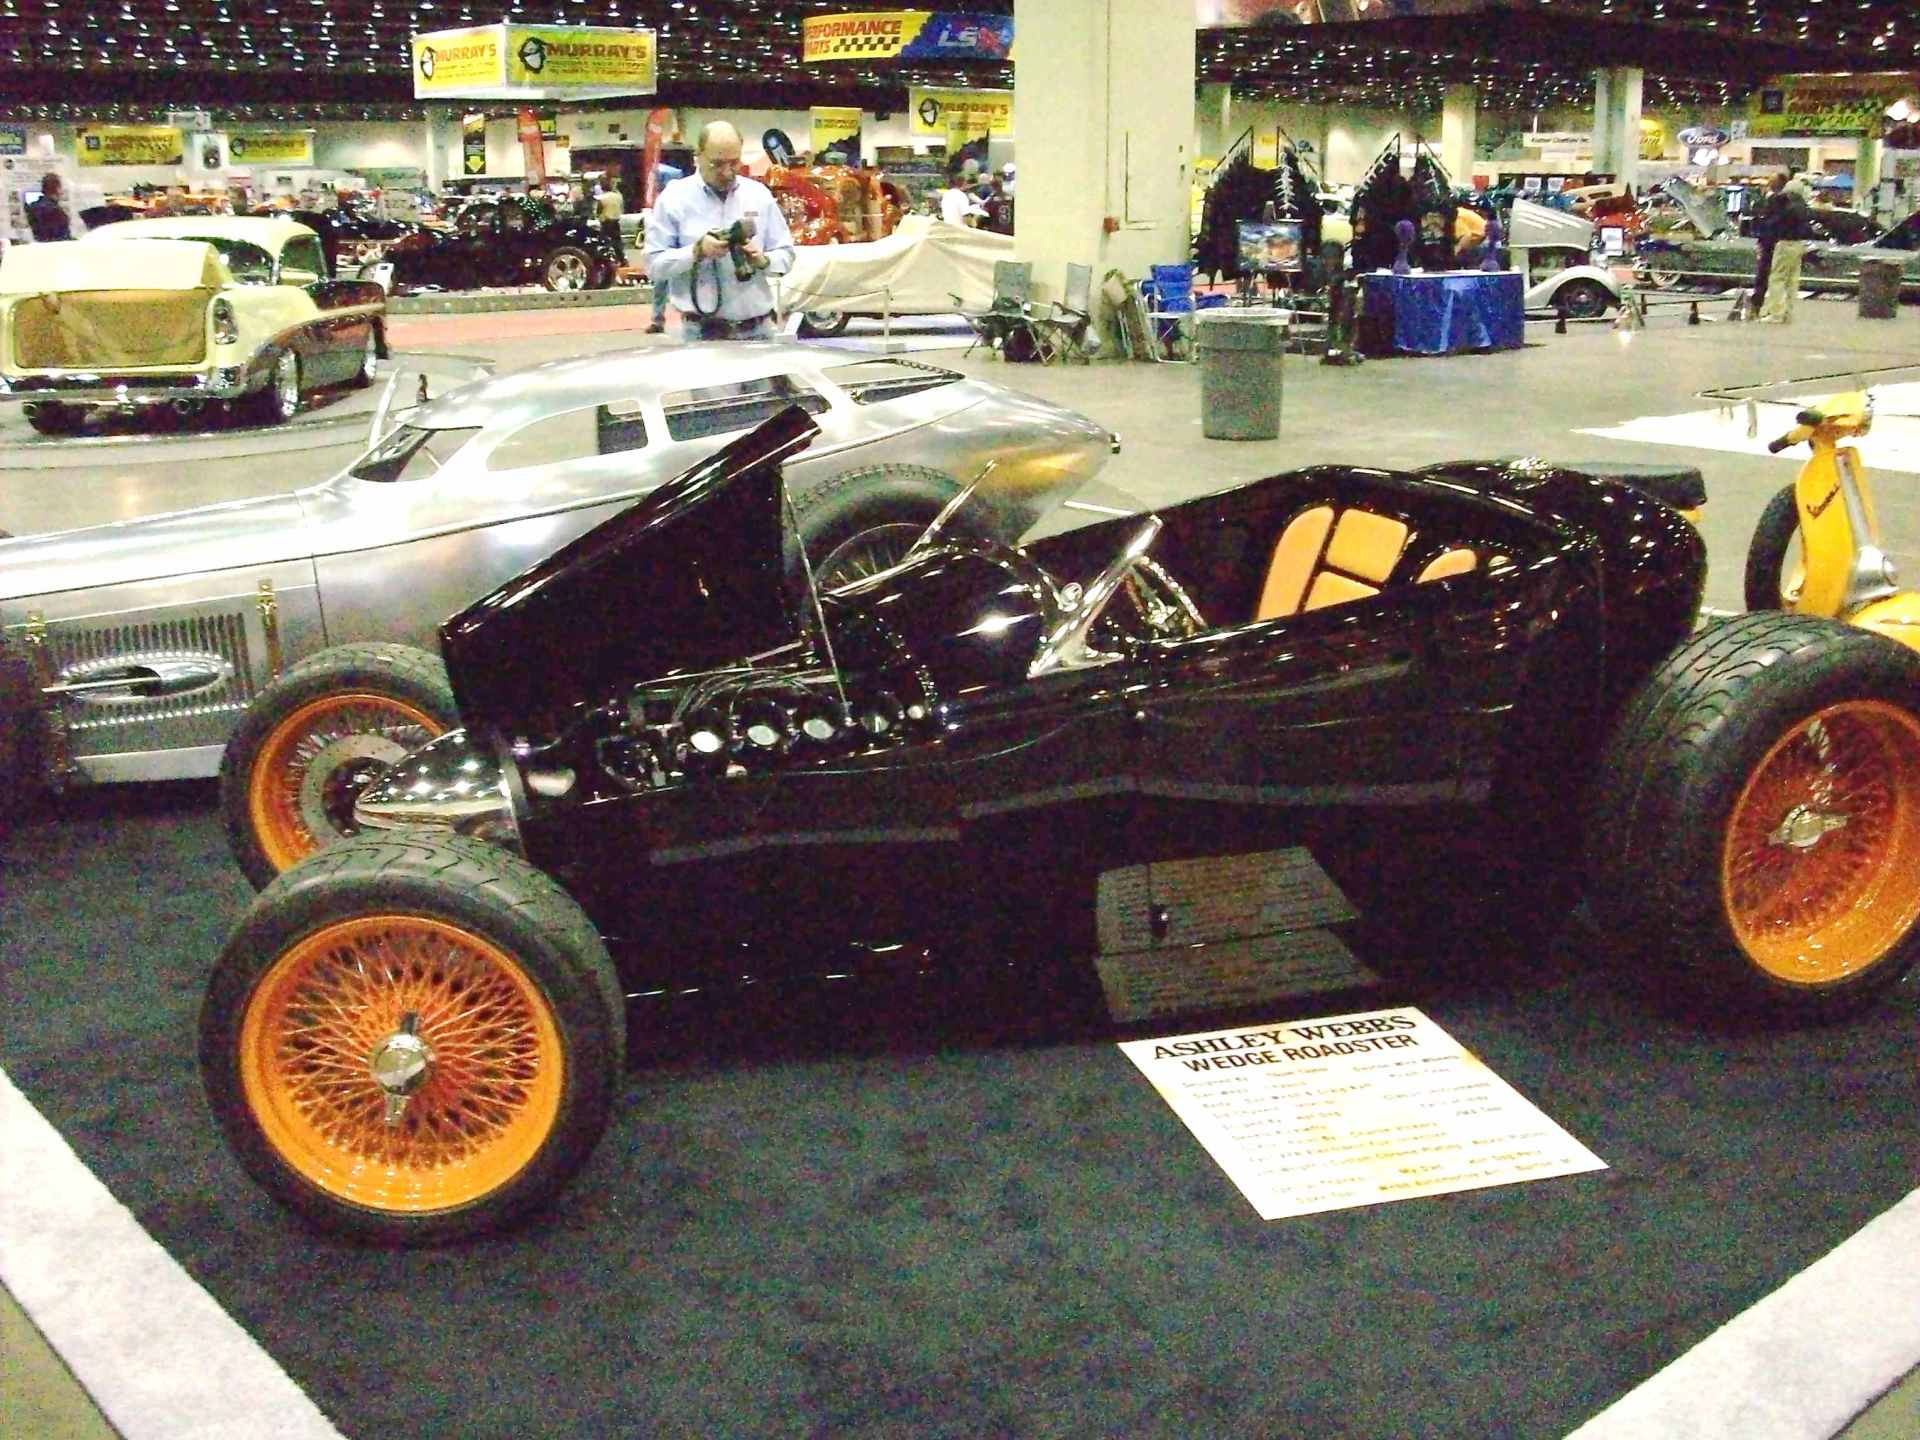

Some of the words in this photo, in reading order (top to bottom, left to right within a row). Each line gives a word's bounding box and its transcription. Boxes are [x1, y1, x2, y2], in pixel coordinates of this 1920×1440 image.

[435, 44, 497, 64] MURRAY'S
[546, 43, 647, 59] MURRAY'S
[1154, 1031, 1286, 1059] ASHLEY
[1183, 1051, 1282, 1072] WEDGE
[1283, 1035, 1419, 1061] ROADSTER
